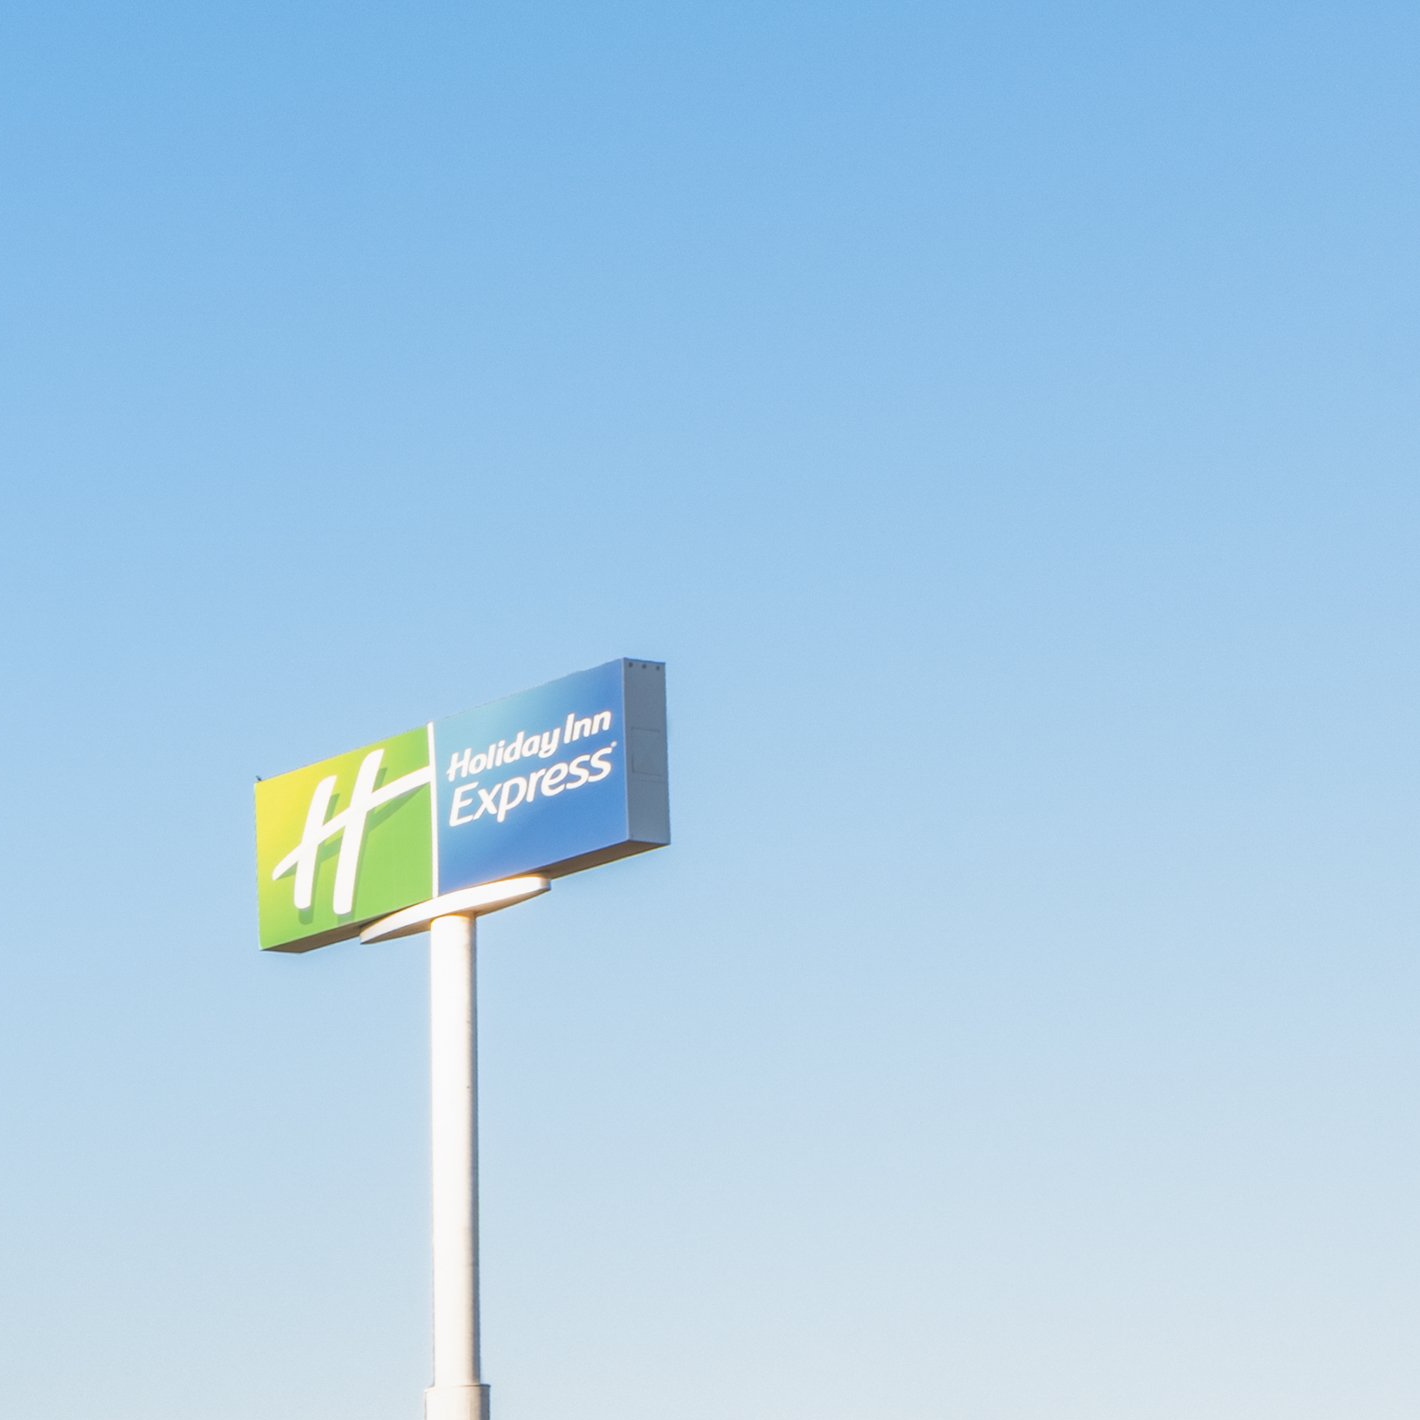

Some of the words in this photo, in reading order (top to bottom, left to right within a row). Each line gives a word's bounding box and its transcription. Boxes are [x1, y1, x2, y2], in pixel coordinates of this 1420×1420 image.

[447, 725, 560, 781] Holiday
[564, 710, 612, 743] Inn
[448, 743, 613, 827] Express
